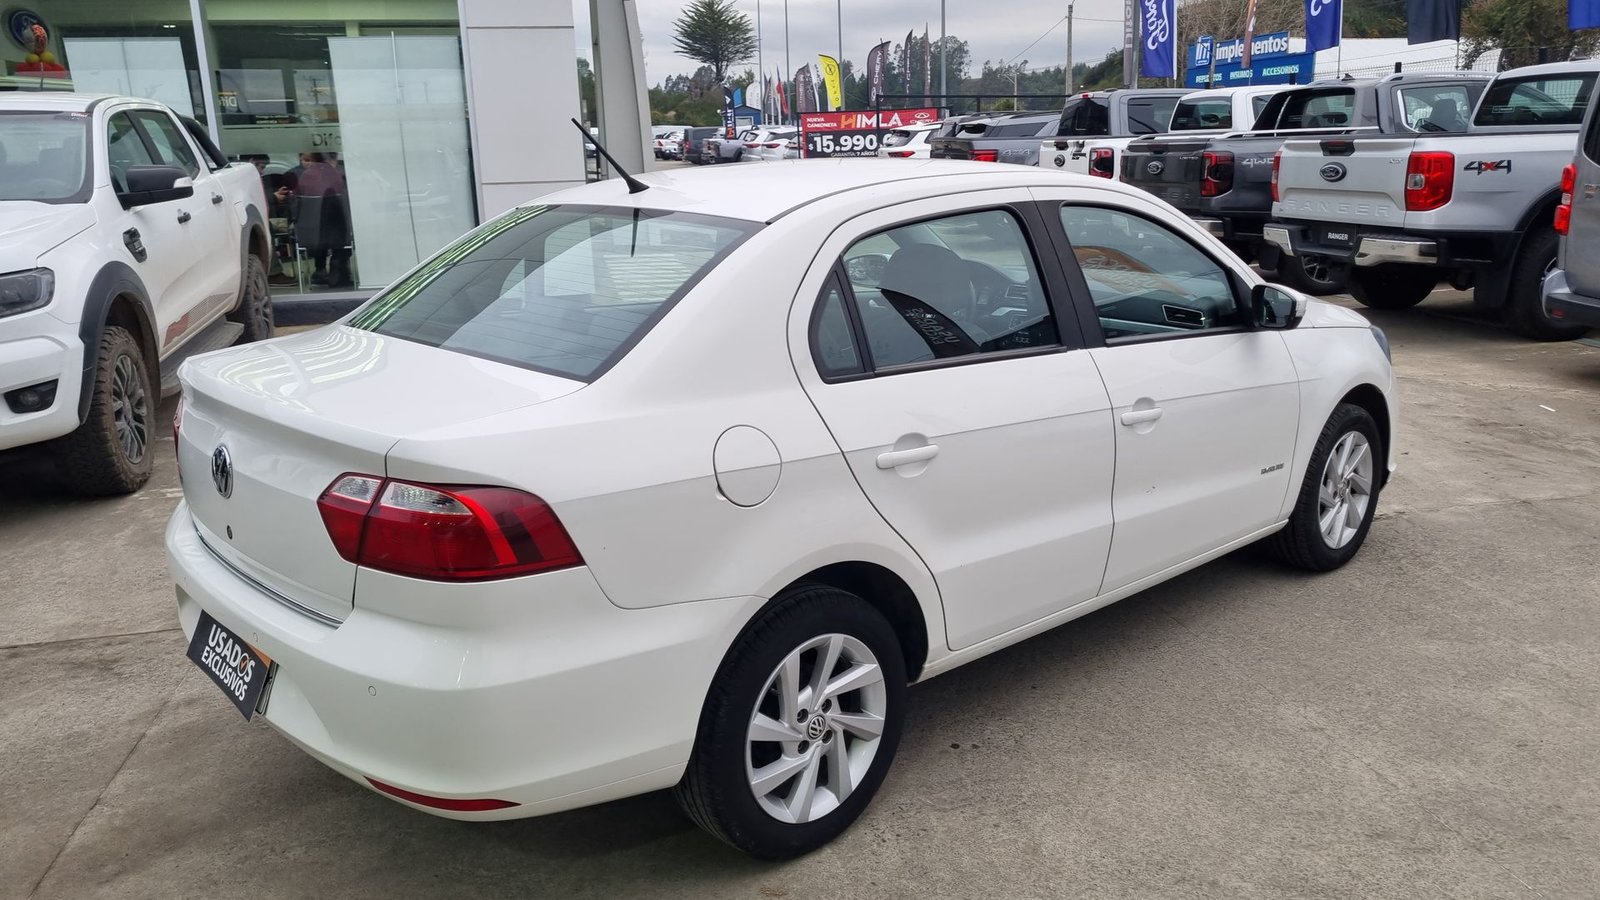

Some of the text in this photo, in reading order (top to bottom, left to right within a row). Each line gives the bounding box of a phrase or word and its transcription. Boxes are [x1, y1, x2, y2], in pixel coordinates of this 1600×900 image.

[1229, 69, 1253, 80] INSUMOS
[1262, 65, 1299, 77] ACCESORIOS
[841, 112, 902, 128] HIMLA
[1463, 159, 1512, 175] 4x4
[1286, 200, 1390, 217] RANGER
[1327, 232, 1349, 241] RANGER
[208, 623, 256, 683] USADOS
[201, 646, 248, 702] EXCLUSIVOS
